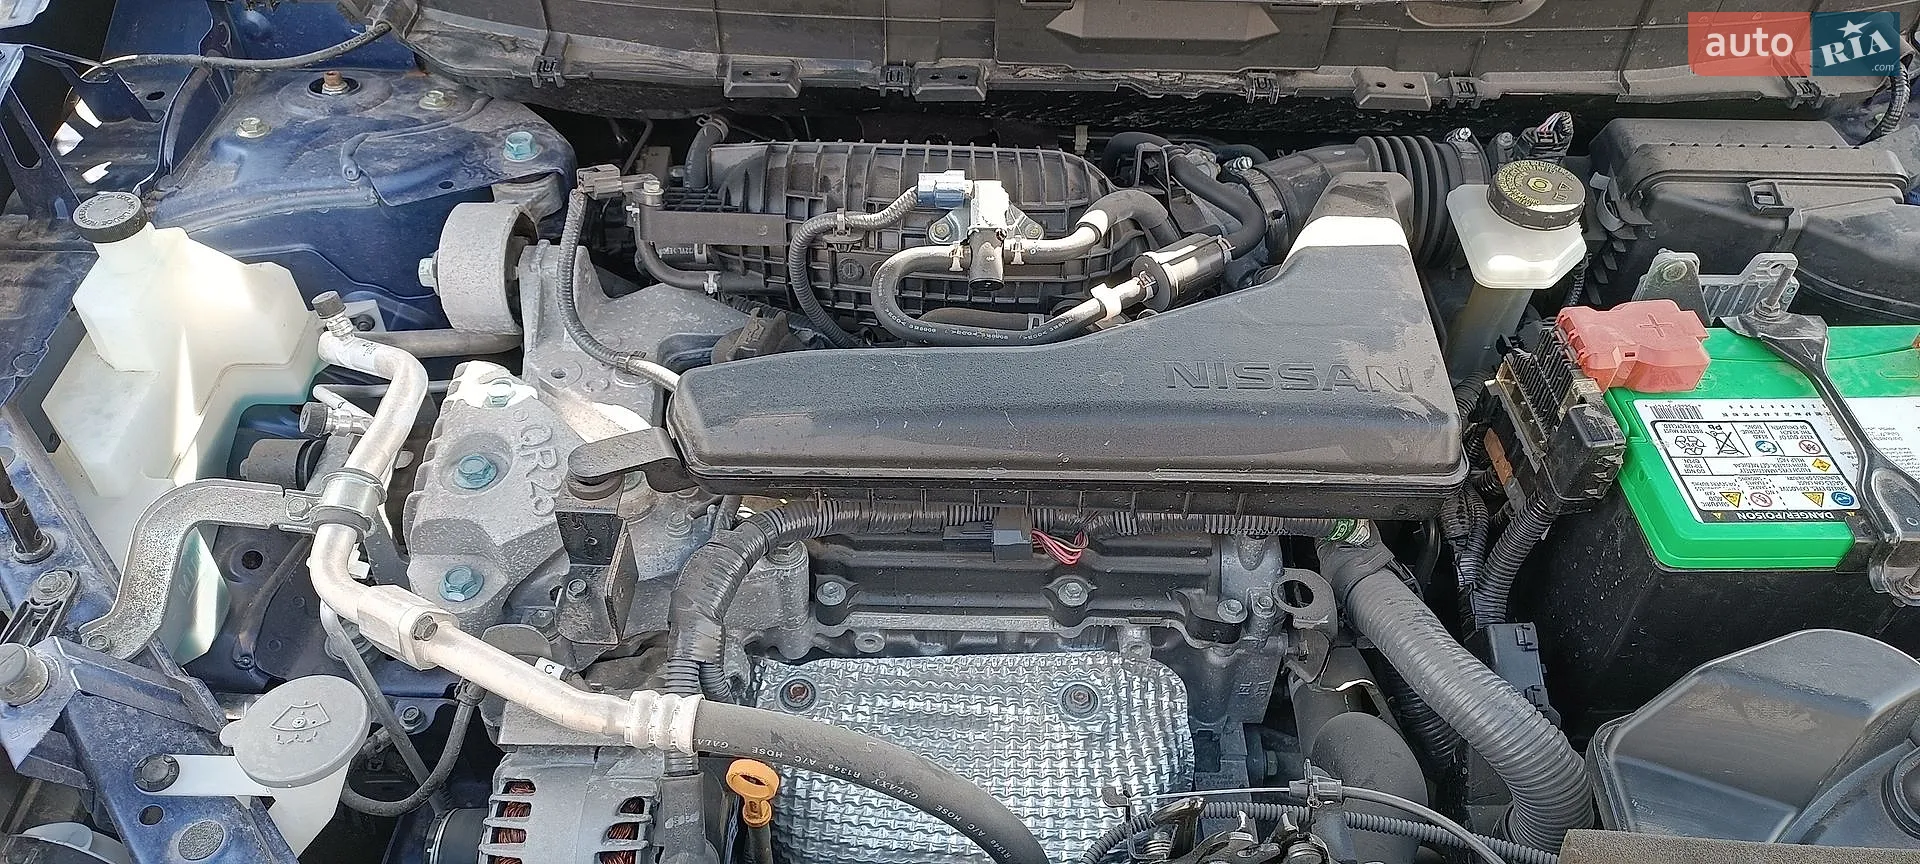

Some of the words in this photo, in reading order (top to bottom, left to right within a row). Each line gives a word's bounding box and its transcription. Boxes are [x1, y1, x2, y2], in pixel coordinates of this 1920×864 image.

[1163, 360, 1415, 393] NISSAN
[518, 424, 563, 516] QR25
[1736, 511, 1835, 520] DANGER/POISON
[693, 738, 729, 749] GALA
[751, 746, 783, 758] HOSE
[794, 755, 816, 766] A/C
[871, 779, 919, 800] GALAXY
[935, 804, 961, 822] HOSE
[967, 823, 986, 837] A/C
